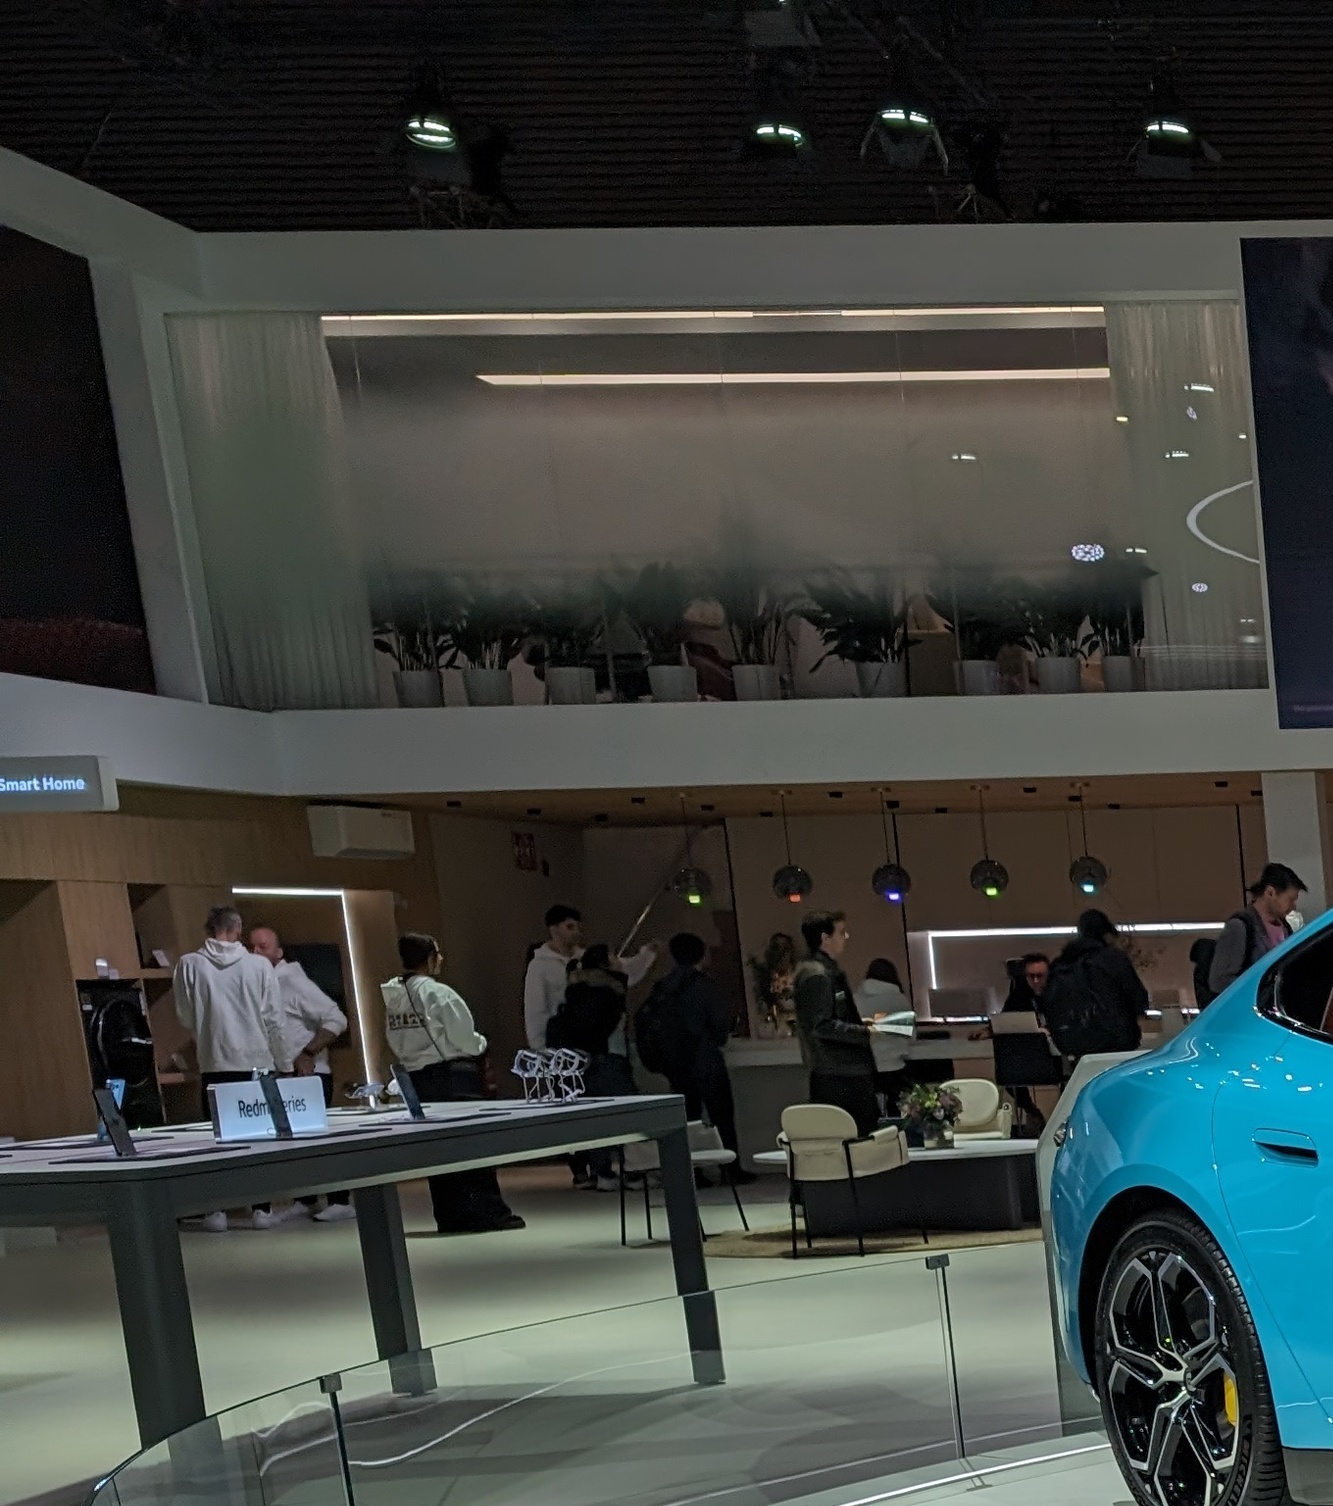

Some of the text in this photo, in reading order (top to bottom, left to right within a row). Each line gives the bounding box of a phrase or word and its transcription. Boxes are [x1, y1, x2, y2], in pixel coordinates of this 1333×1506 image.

[0, 776, 85, 791] Smart Home
[238, 1095, 306, 1118] Redm eries
